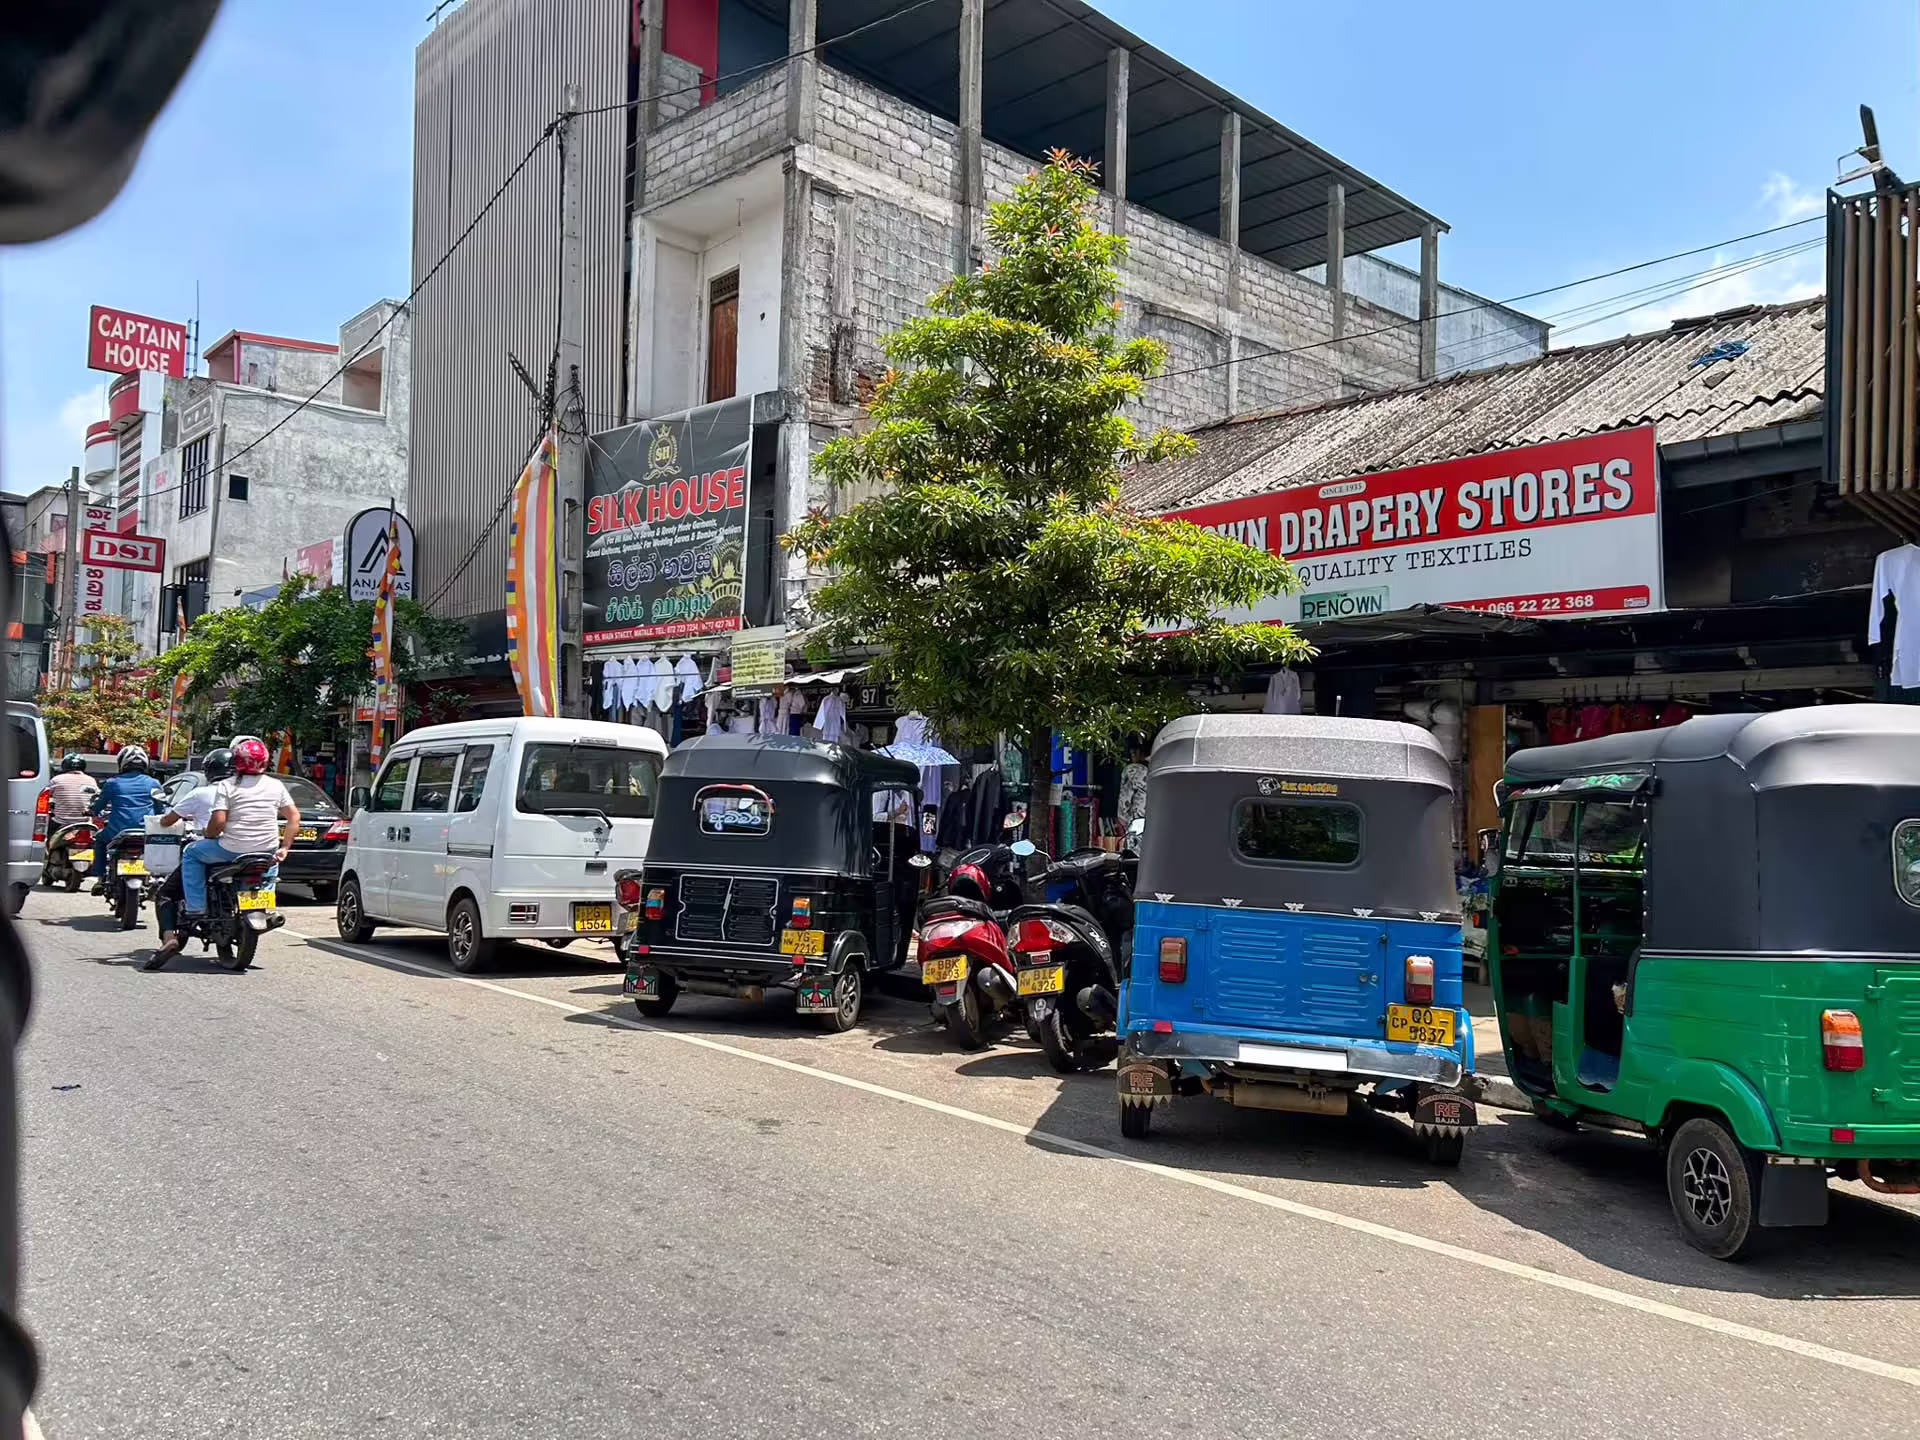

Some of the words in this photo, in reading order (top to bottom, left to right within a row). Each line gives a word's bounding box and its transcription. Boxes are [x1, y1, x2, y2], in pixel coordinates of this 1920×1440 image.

[97, 314, 181, 352] CAPTAIN
[104, 346, 170, 373] HOUSE
[1322, 485, 1343, 496] SINCE
[586, 487, 648, 535] SILK
[646, 466, 746, 524] HOUSE
[1280, 487, 1446, 556] DRAPERY
[1457, 457, 1634, 530] STORES
[95, 540, 152, 561] DSI
[1298, 554, 1398, 587] QUALITY
[1405, 538, 1532, 570] TEXTILES
[1302, 595, 1383, 620] RENOWN
[1488, 602, 1515, 613] 066
[1519, 600, 1537, 612] 22
[1542, 597, 1561, 609] 22
[1565, 595, 1594, 608] 368
[862, 688, 876, 704] 97
[586, 906, 601, 918] PG
[579, 918, 607, 930] 1564
[794, 943, 817, 954] 7216
[937, 958, 960, 970] BBK
[1032, 980, 1056, 992] 4326
[1392, 1017, 1408, 1028] CP
[1130, 1072, 1153, 1087] RE
[1434, 1101, 1461, 1118] RE
